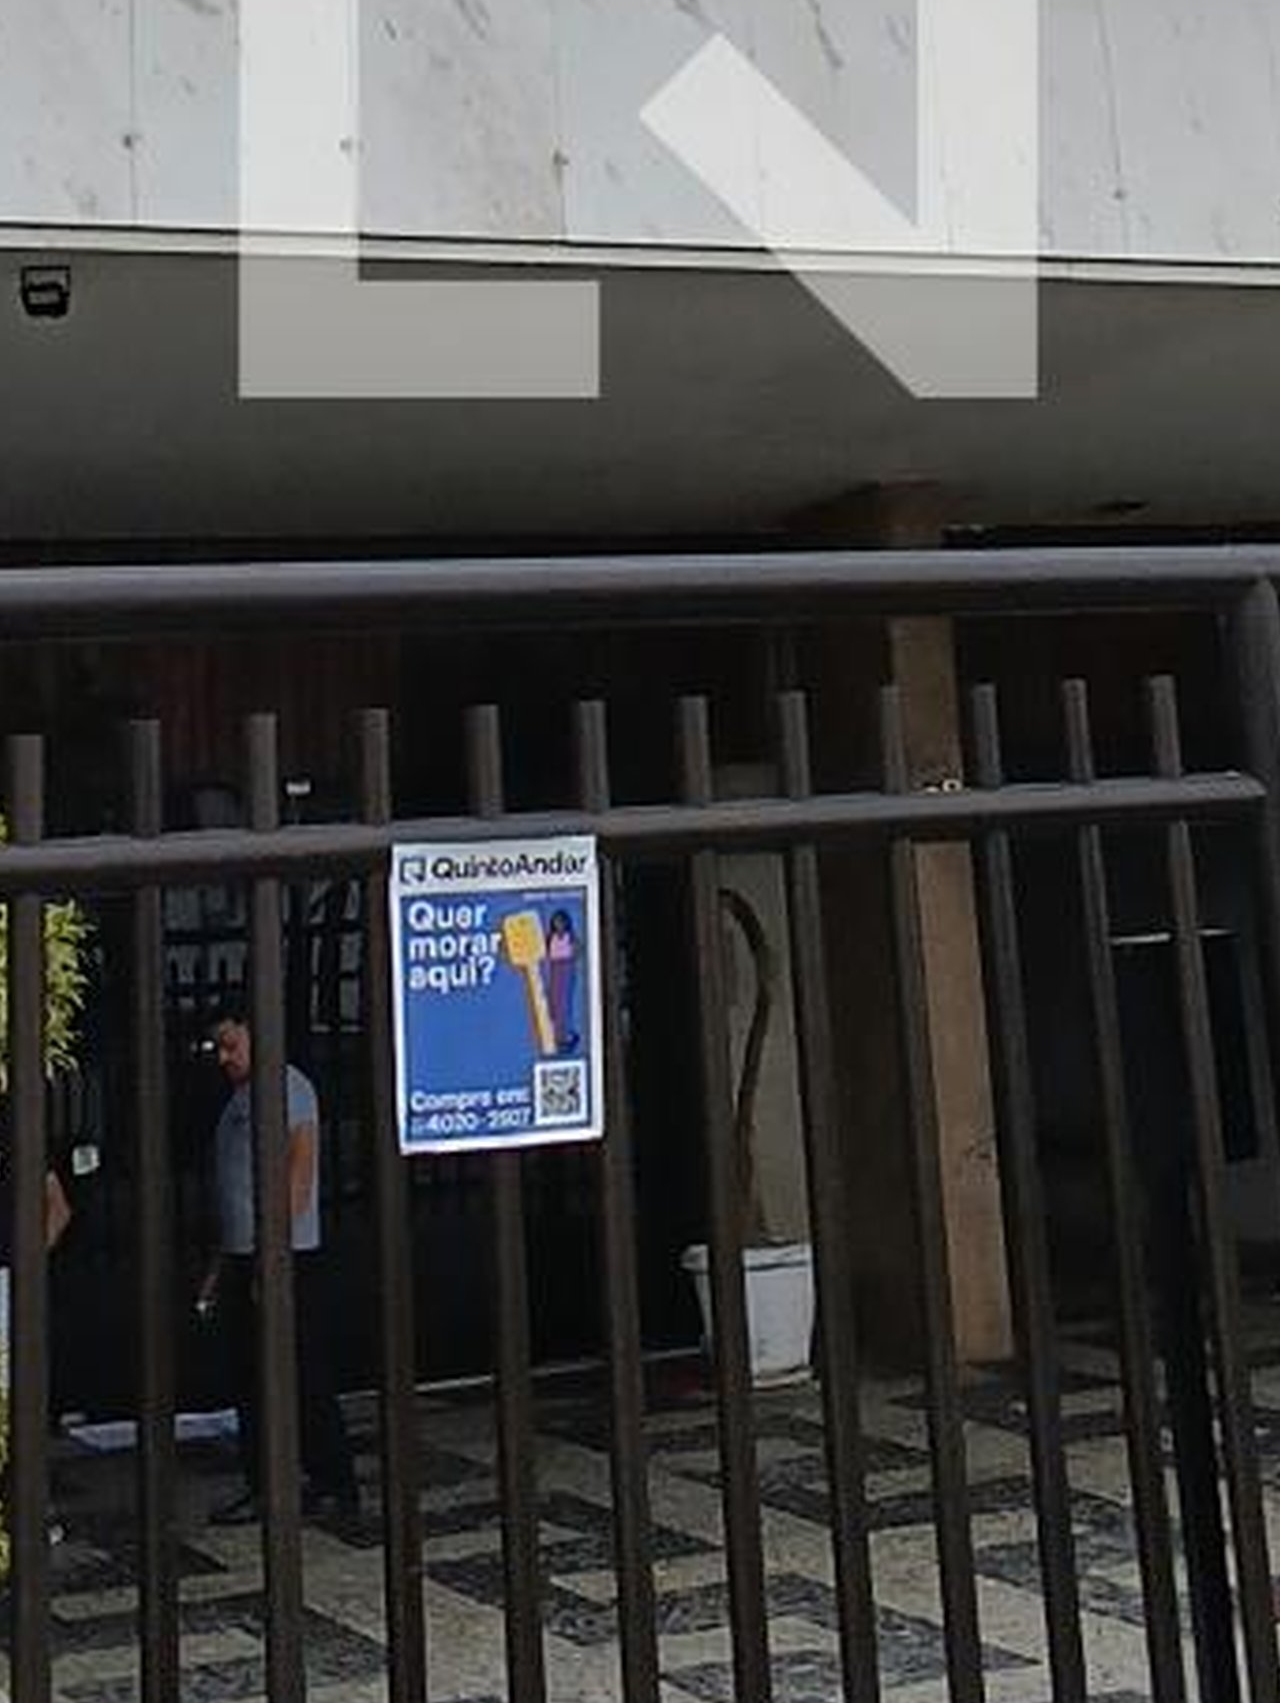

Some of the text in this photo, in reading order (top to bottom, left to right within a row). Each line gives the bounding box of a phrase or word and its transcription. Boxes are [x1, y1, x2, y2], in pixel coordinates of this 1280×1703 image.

[431, 851, 588, 880] QuintoAndar
[408, 900, 488, 932] Quer
[409, 932, 503, 961] morar
[409, 956, 496, 994] aqui?
